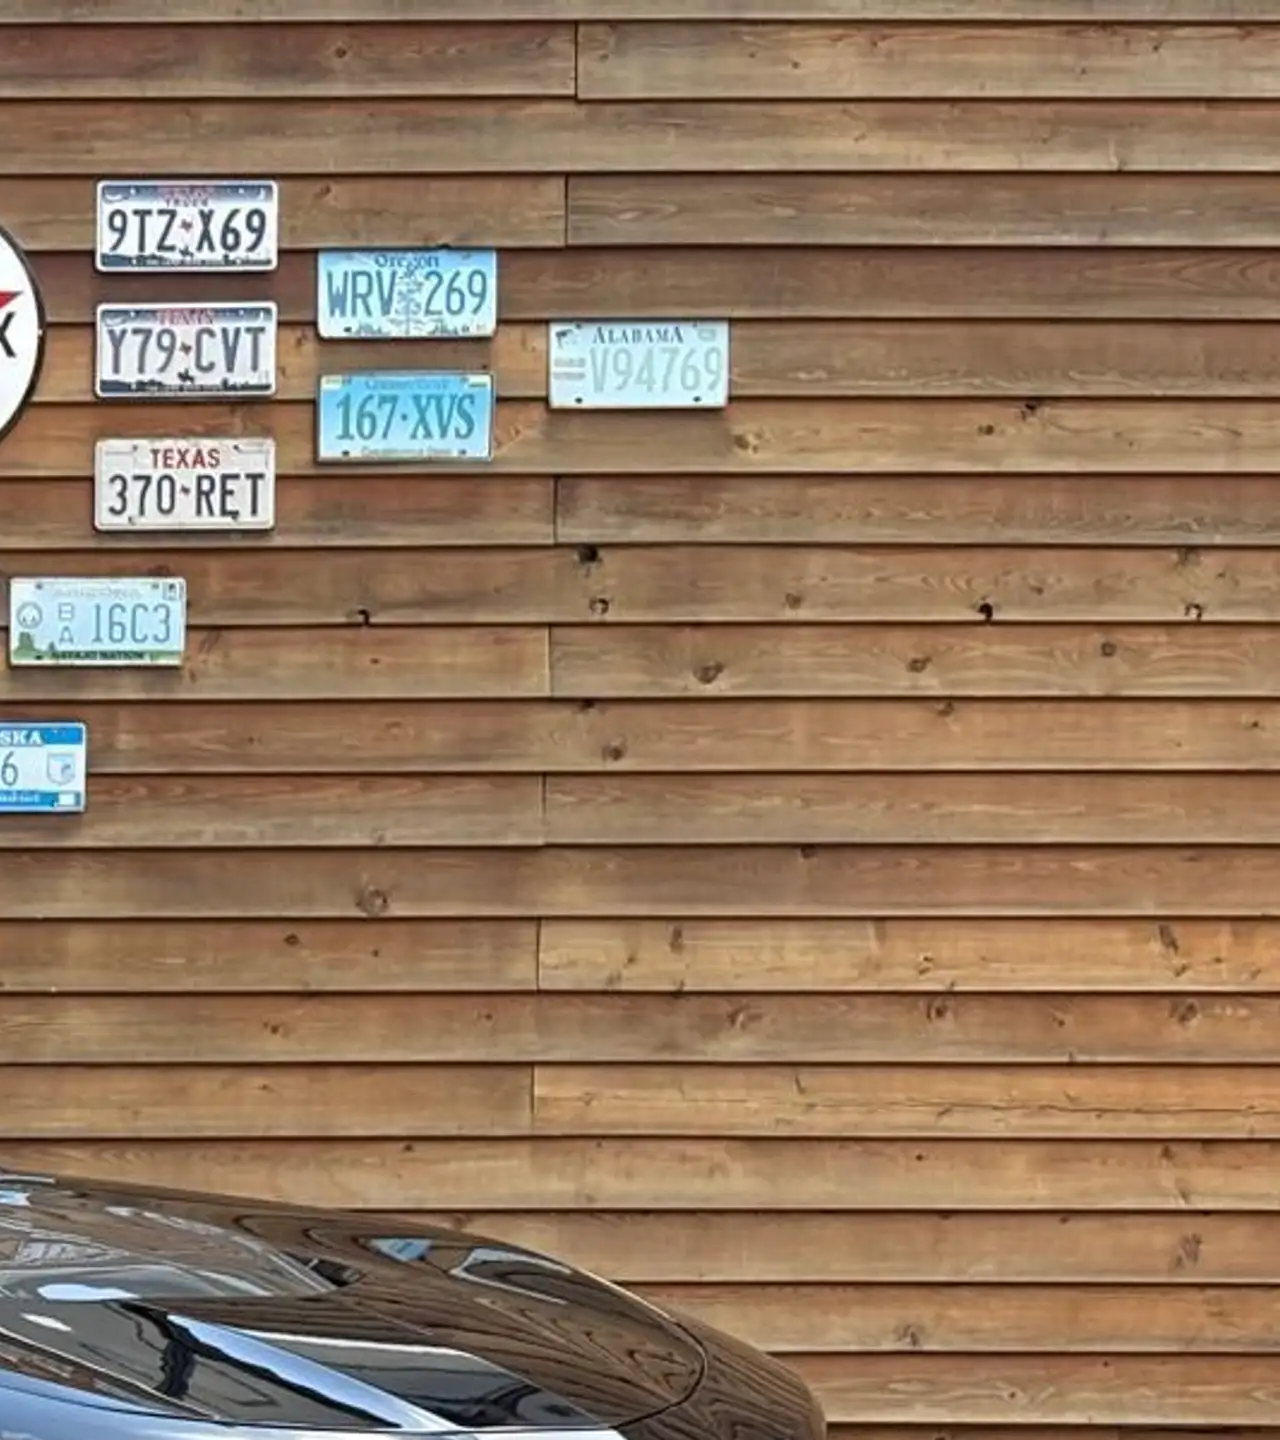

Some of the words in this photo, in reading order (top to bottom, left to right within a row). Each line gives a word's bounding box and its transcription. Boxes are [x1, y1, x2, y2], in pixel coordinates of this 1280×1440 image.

[374, 253, 440, 271] Oregon
[593, 326, 684, 344] ALABAMA
[590, 347, 723, 393] V94769
[149, 448, 221, 470] TEXAS
